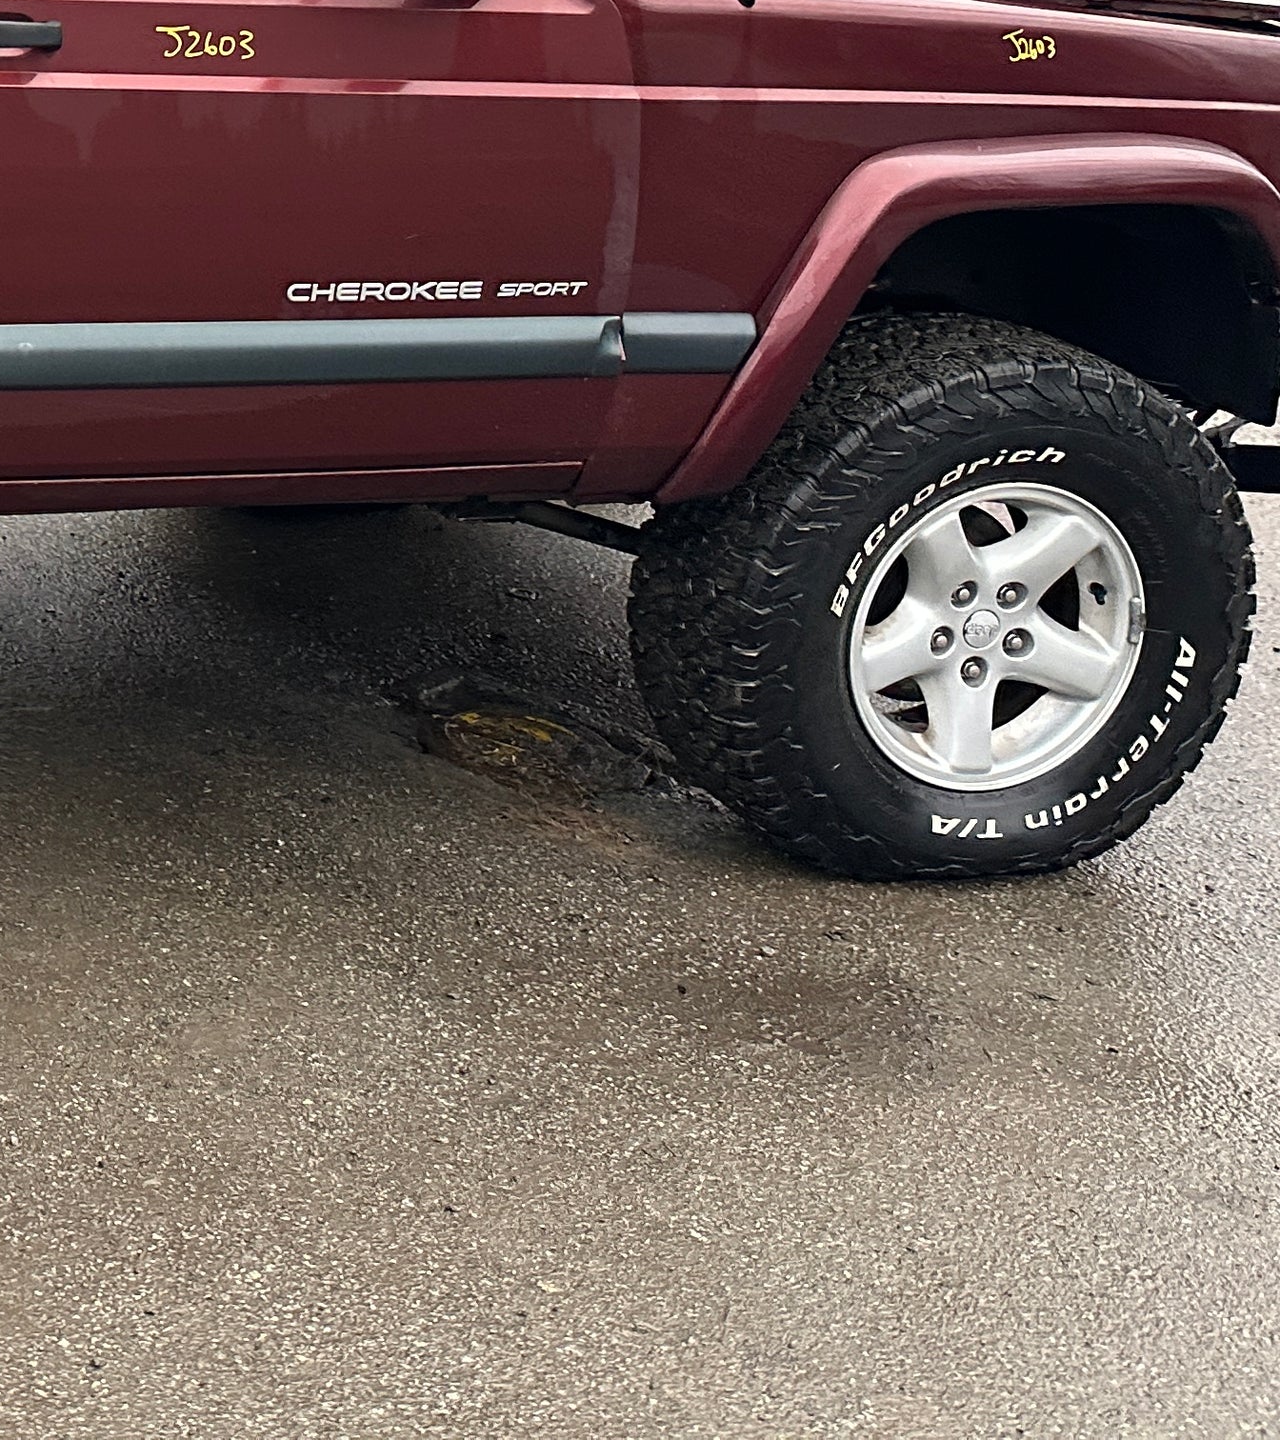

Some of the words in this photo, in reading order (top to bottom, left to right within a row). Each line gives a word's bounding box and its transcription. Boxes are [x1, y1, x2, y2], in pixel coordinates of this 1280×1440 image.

[155, 25, 256, 60] J2603
[1002, 28, 1057, 62] J2603
[286, 280, 484, 302] CHEROKEE
[496, 281, 589, 298] SPORT
[830, 446, 1067, 618] BFGoodrich
[1025, 636, 1198, 830] All-Terrain
[931, 814, 1004, 840] T/A
